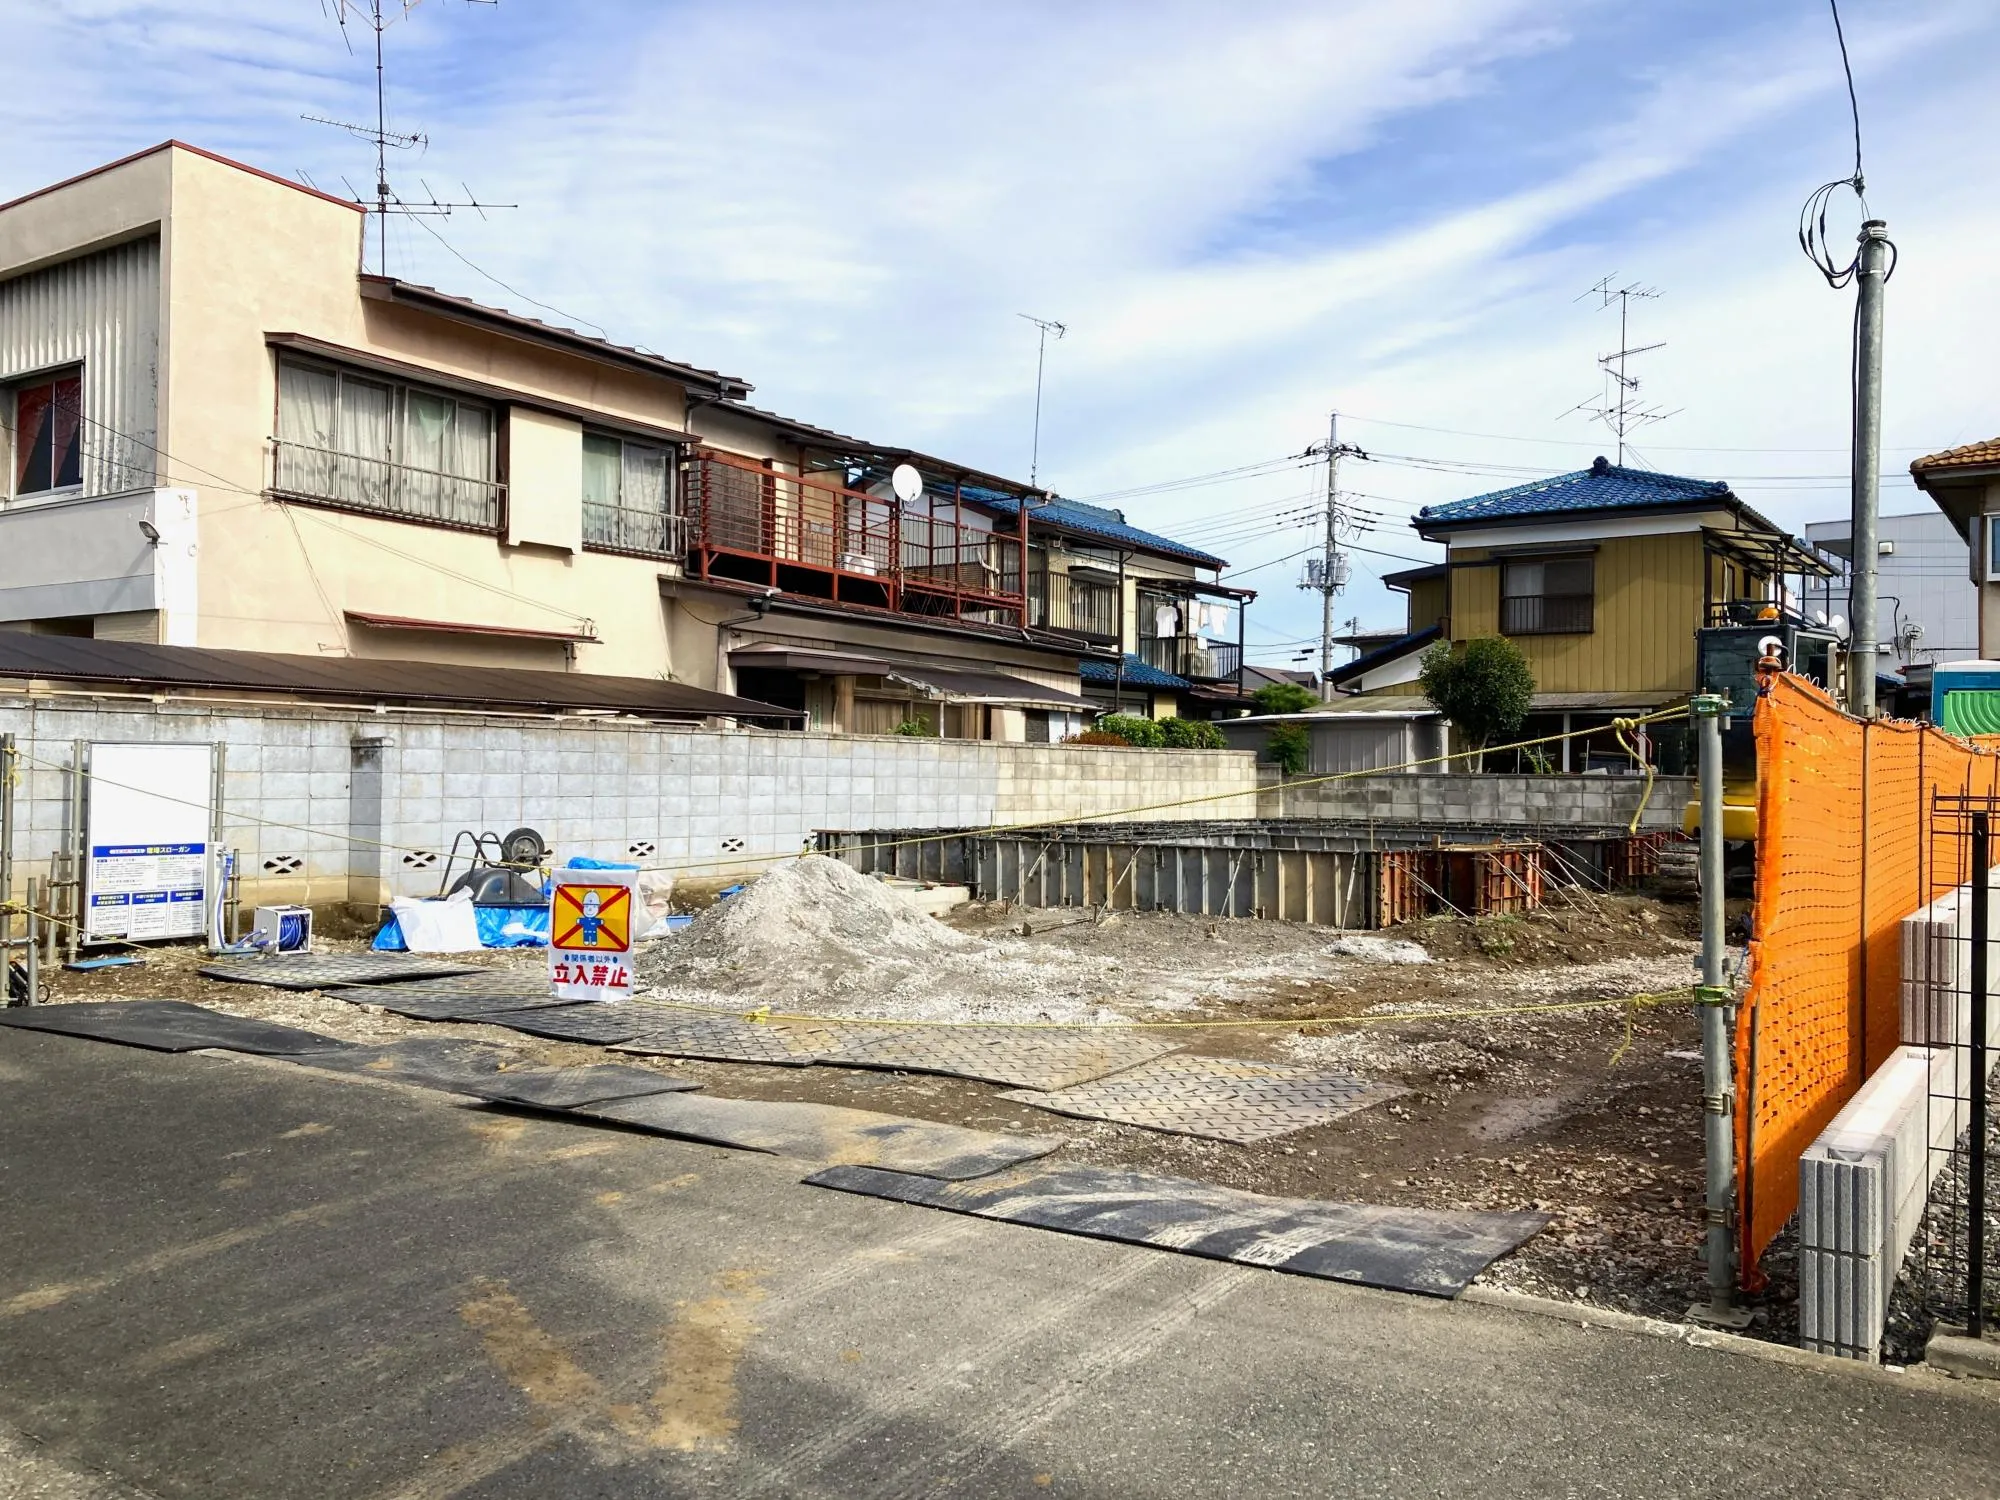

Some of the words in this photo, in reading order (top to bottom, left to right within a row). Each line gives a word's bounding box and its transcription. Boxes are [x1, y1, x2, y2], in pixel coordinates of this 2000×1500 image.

[571, 954, 611, 963] 関係者以外
[553, 963, 628, 987] 立入禁止
